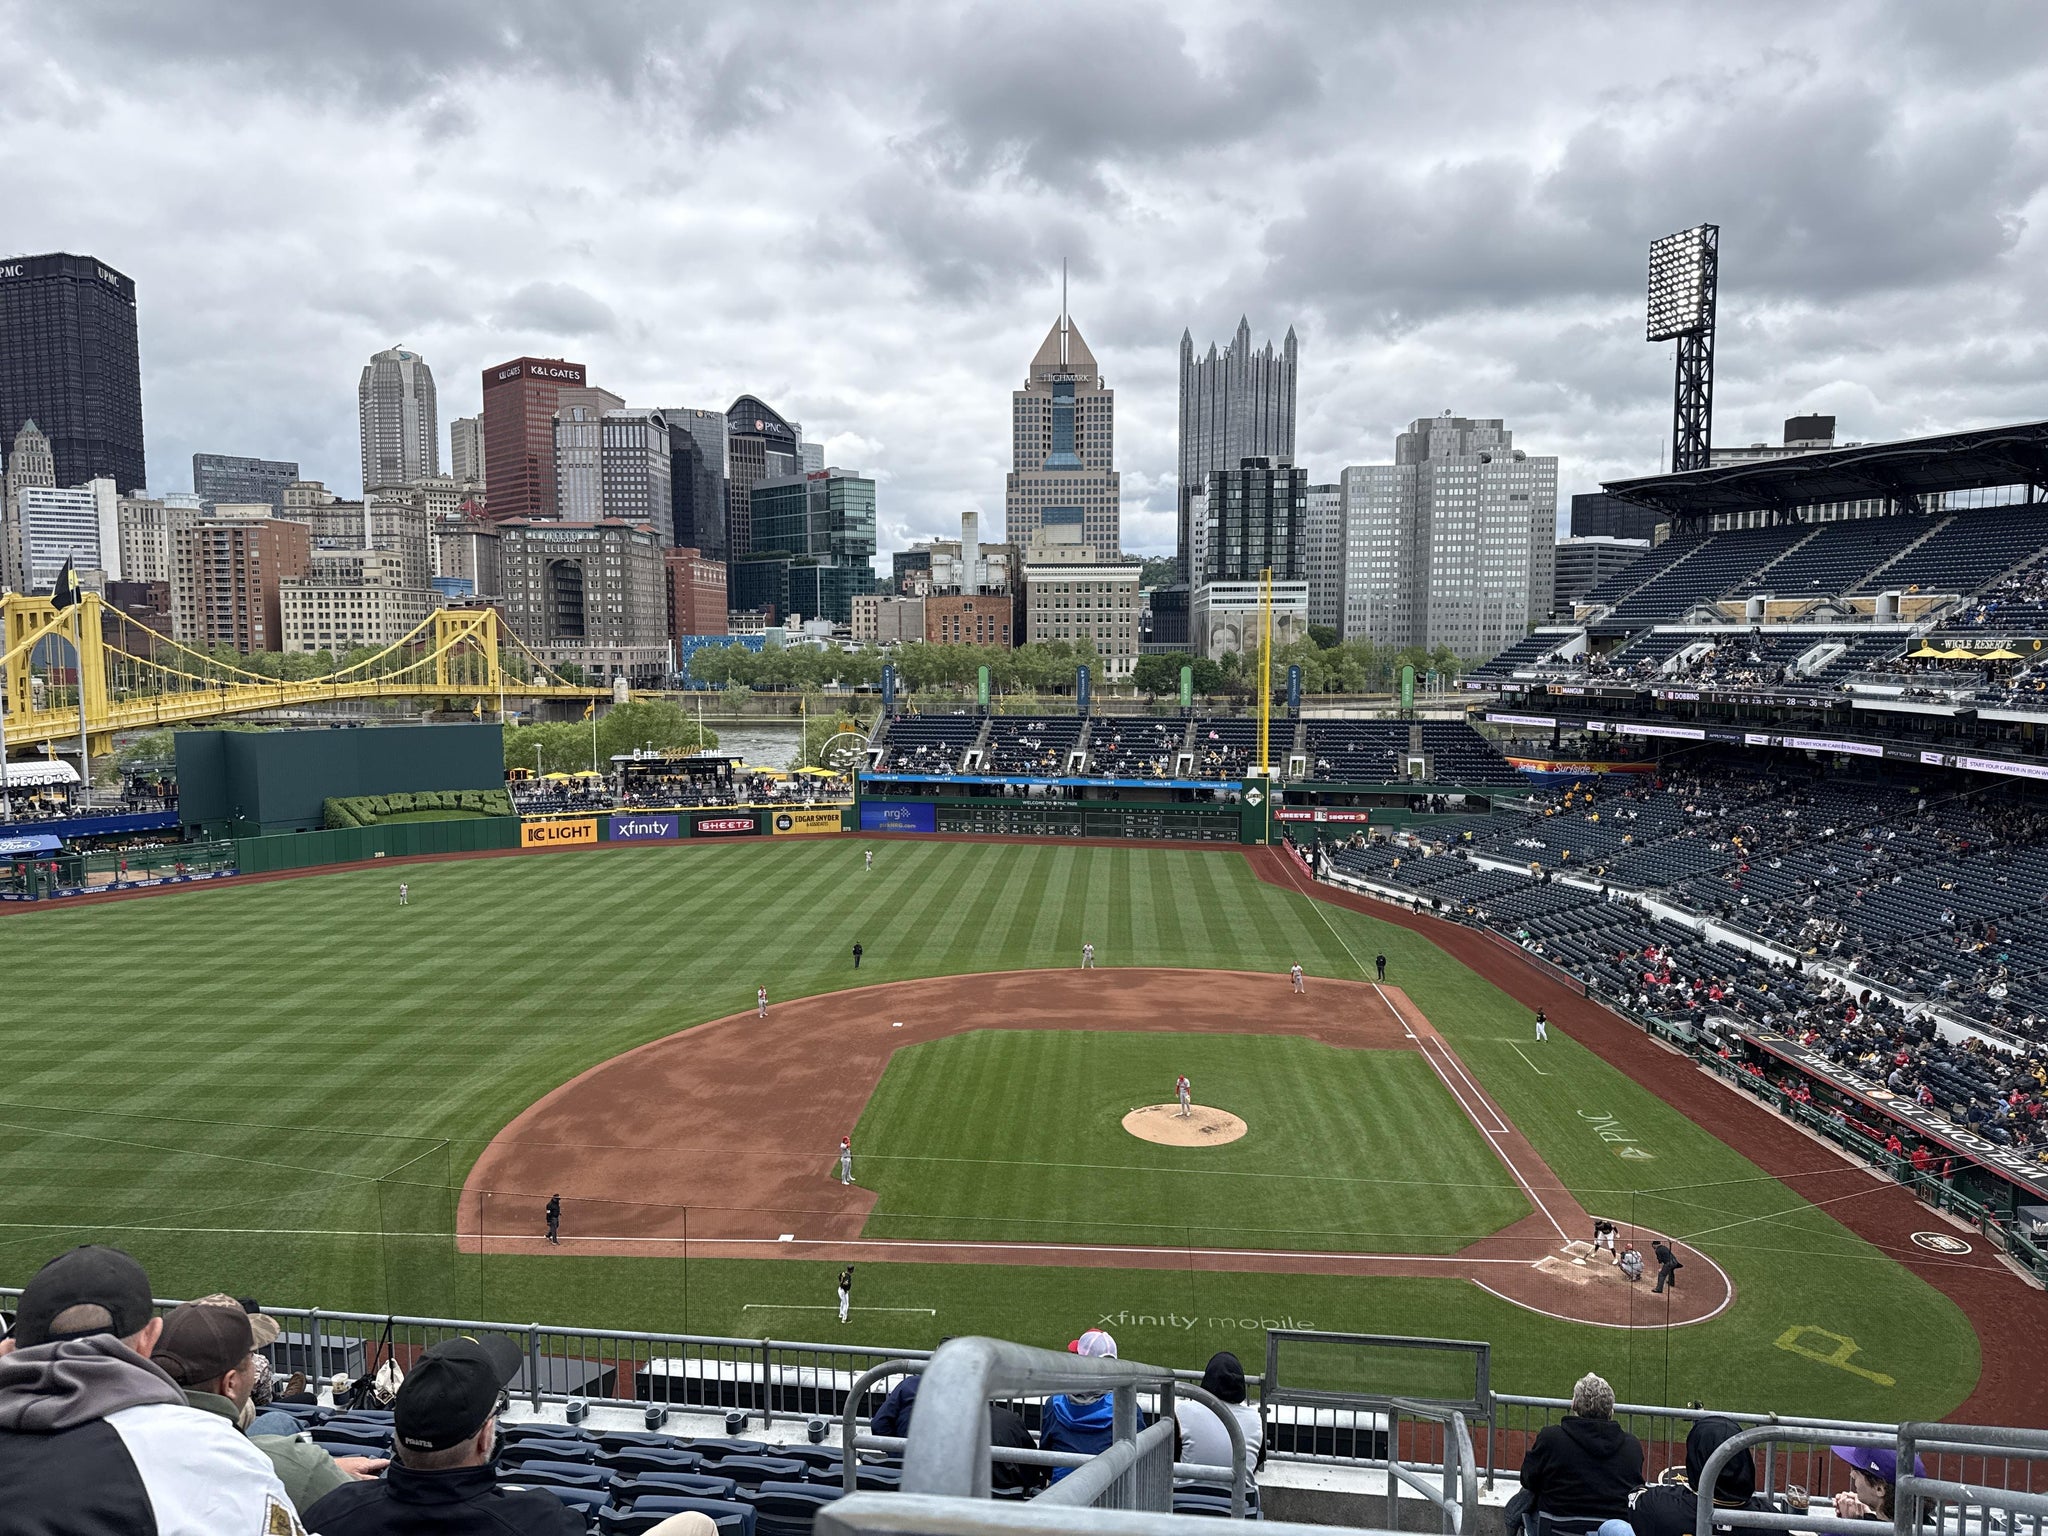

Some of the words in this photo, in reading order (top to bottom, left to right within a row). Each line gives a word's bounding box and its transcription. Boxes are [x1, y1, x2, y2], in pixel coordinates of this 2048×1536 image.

[97, 266, 120, 287] UPMC
[498, 371, 507, 380] K&L
[506, 365, 521, 378] GATES
[530, 365, 548, 376] K&L
[549, 368, 580, 380] GATES
[1043, 374, 1089, 382] HIGHMARK
[764, 421, 782, 433] PNC
[1944, 639, 1973, 649] WIGLE
[1974, 640, 2013, 650] RESERVE
[1501, 684, 1520, 692] DOBBINS
[1562, 687, 1584, 695] MANGUM
[1674, 692, 1699, 701] DOBBINS
[1786, 697, 1796, 706] 28
[1809, 699, 1818, 707] 36
[1824, 700, 1832, 708] 64
[659, 744, 704, 765] Miller
[701, 749, 723, 758] TIME
[1553, 762, 1590, 773] Surfside
[795, 815, 815, 823] EDGAR
[815, 814, 839, 822] SNYDER
[884, 809, 900, 820] nrg
[618, 820, 670, 837] xfinity
[702, 820, 750, 830] SHEETZ
[528, 828, 545, 842] IC
[548, 825, 592, 840] LIGHT
[1795, 1053, 1842, 1074] PARK
[1833, 1073, 1877, 1091] PNC
[1887, 1101, 1925, 1116] TO
[1577, 1109, 1639, 1143] PNC
[1917, 1117, 2048, 1179] WELCOME
[1097, 1310, 1199, 1330] xfinity
[1208, 1315, 1315, 1331] mobile
[405, 1437, 433, 1448] PIRATES
